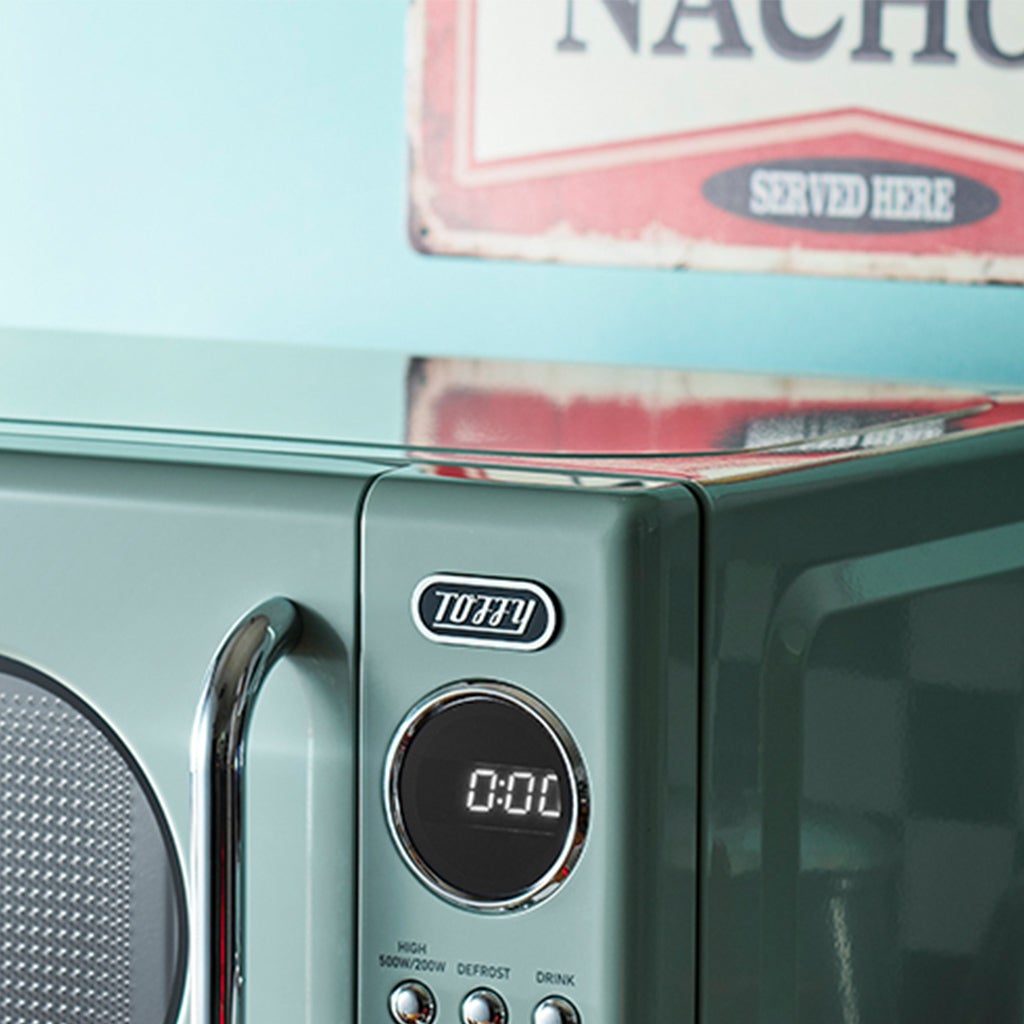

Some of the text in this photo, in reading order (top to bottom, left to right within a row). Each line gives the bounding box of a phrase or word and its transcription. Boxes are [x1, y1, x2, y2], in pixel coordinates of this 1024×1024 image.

[749, 167, 956, 223] SERVED HERE
[397, 942, 426, 954] HIGH
[378, 954, 446, 972] 500W/200W
[457, 963, 511, 979] DEFROST
[536, 972, 575, 986] DRINK
